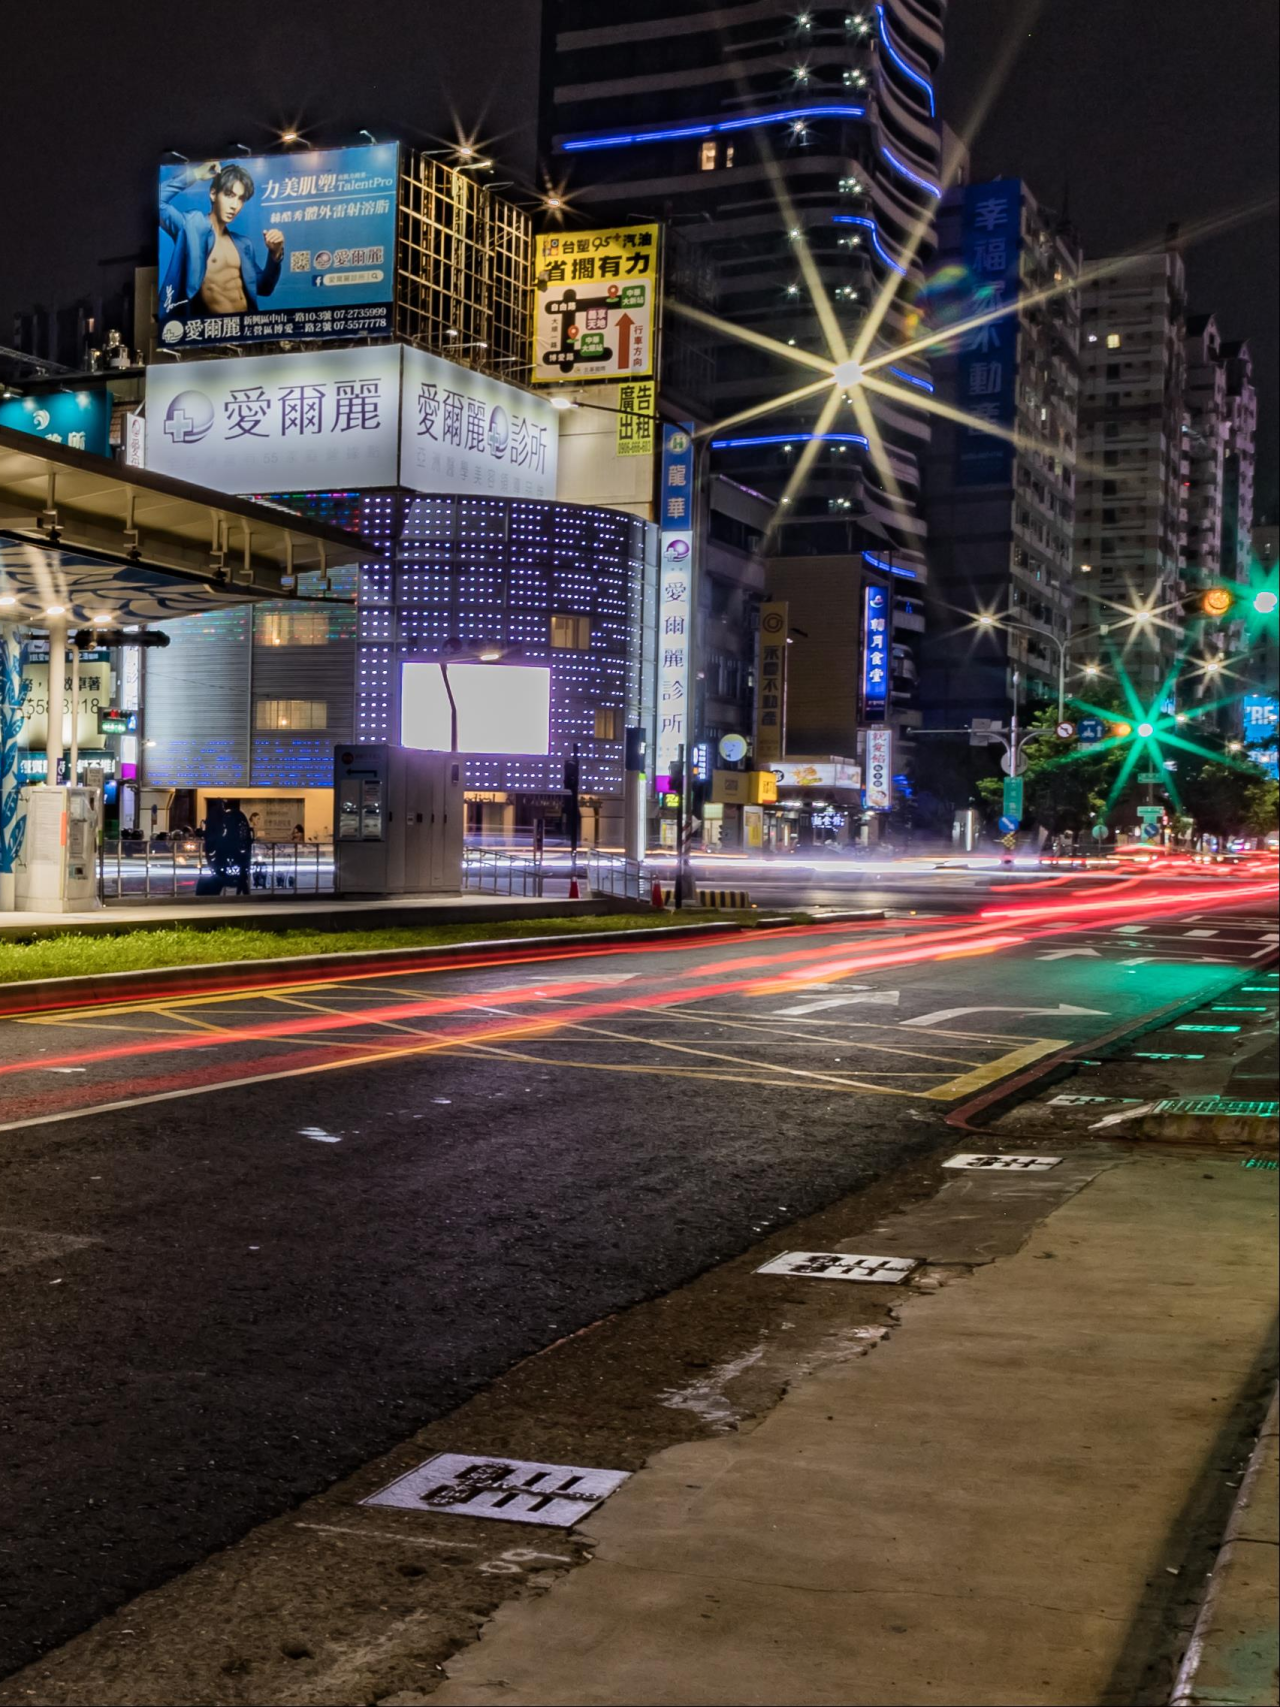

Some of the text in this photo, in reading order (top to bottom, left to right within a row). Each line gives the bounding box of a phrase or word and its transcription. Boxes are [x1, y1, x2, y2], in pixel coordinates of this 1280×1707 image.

[261, 173, 337, 200] 力美肌塑
[336, 177, 393, 192] TalentPro
[333, 246, 384, 268] 愛爾麗
[546, 252, 651, 281] 省擱有力
[333, 307, 387, 320] 07-2735999
[551, 301, 576, 312] 自由路
[185, 316, 241, 341] 愛爾麗
[333, 318, 387, 331] 07-5577778
[633, 325, 644, 367] 行車方向
[223, 378, 382, 442] 愛爾麗
[620, 385, 652, 412] 廣告
[417, 382, 547, 475] 愛爾麗 診所
[619, 412, 651, 441] 出租
[667, 464, 686, 519] 龍華
[661, 581, 687, 734] 愛爾麗診所
